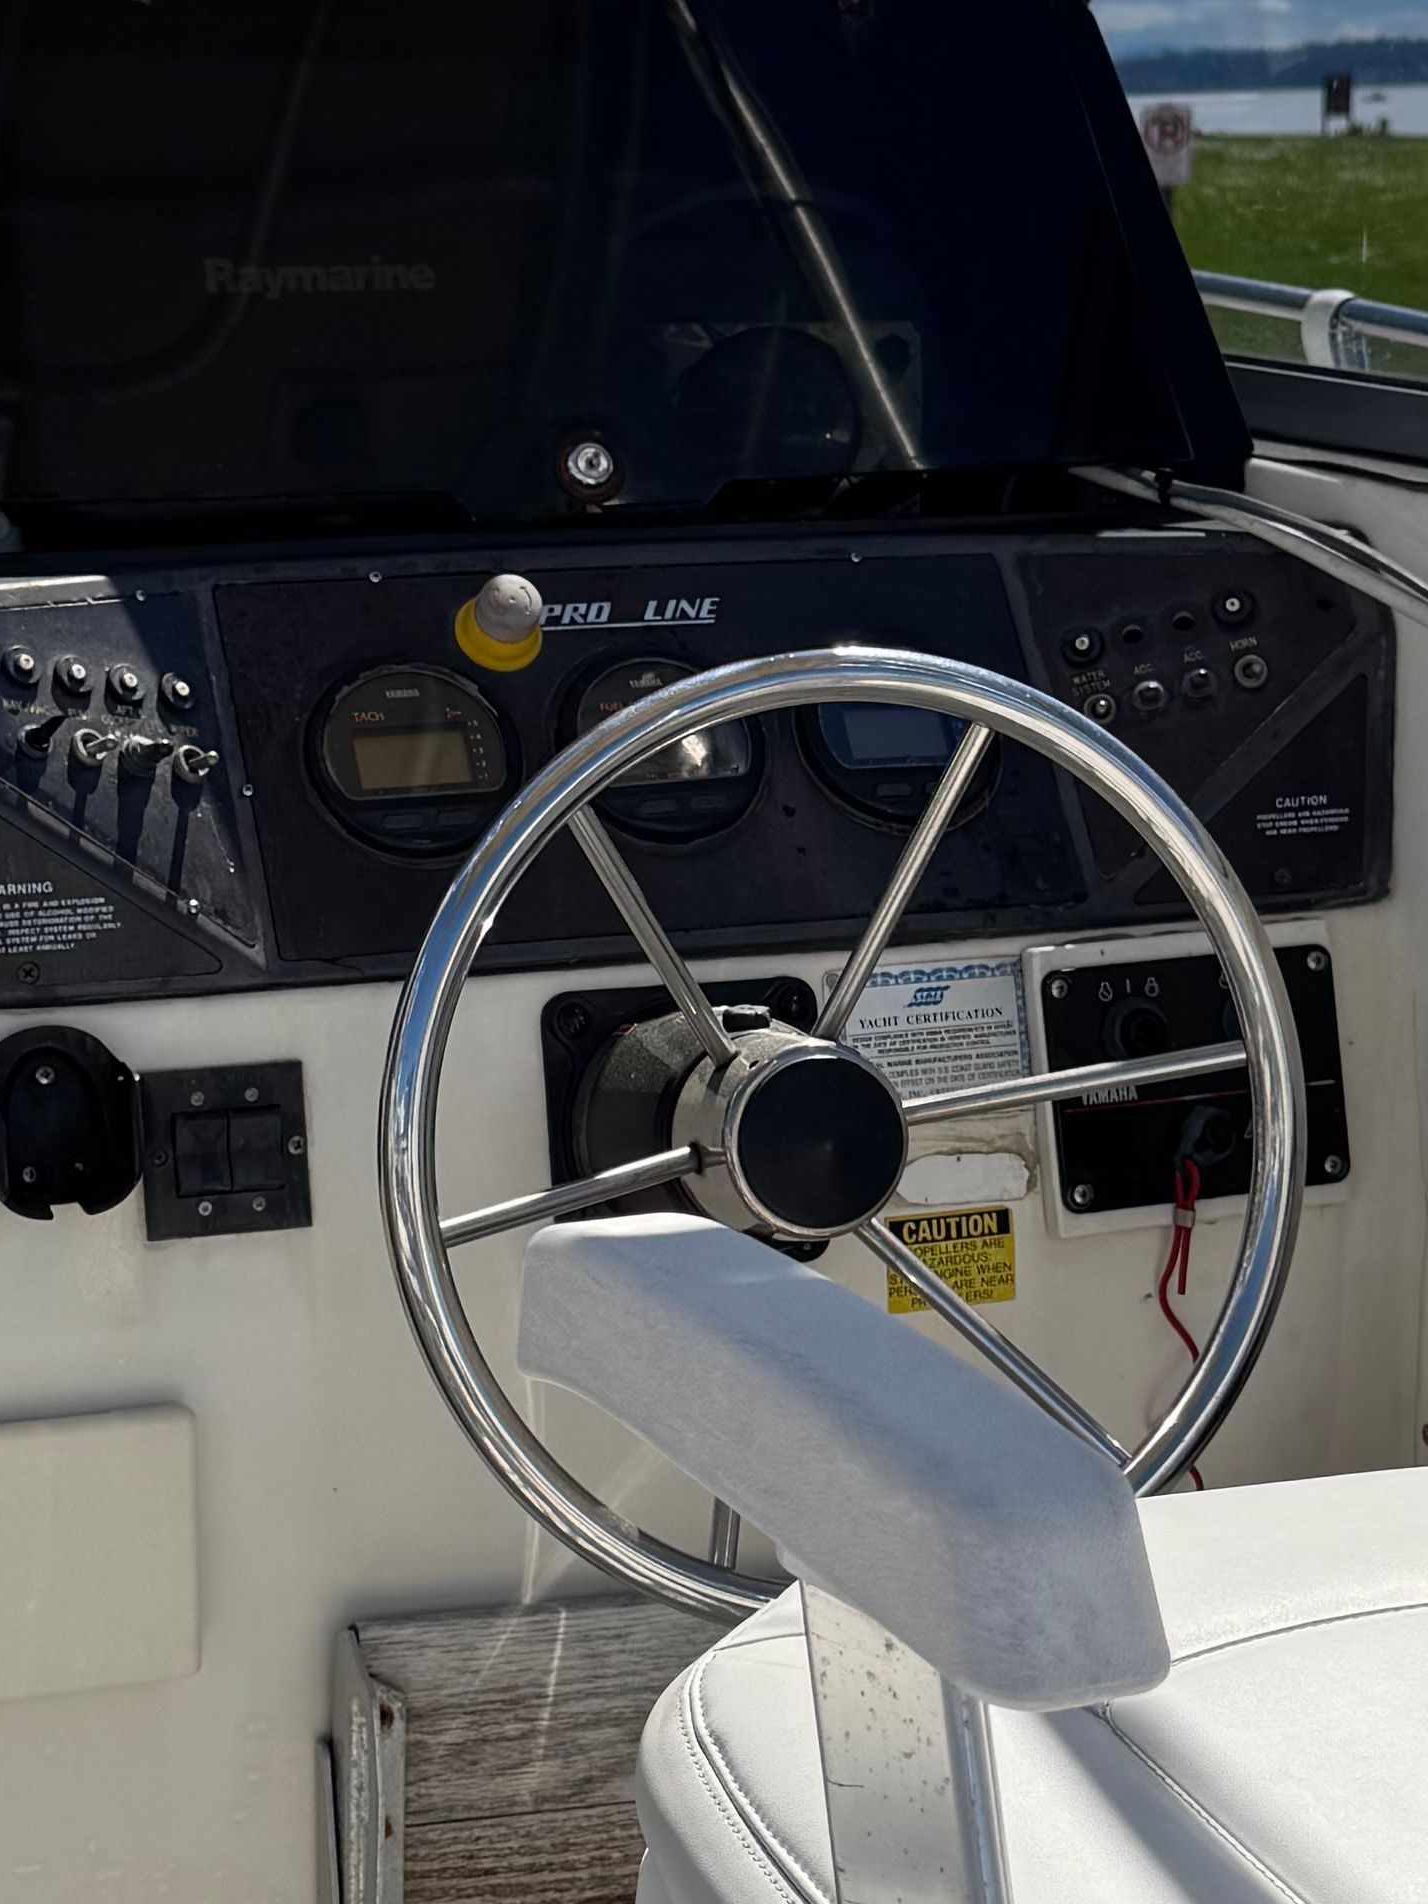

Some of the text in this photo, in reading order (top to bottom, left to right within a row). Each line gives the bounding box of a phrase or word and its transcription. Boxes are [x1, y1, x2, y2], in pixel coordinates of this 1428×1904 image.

[202, 255, 436, 300] Raymarine
[540, 597, 720, 625] PRO LINE
[1229, 637, 1259, 652] HORN
[352, 711, 385, 722] TACH
[1275, 794, 1327, 809] CAUTION
[859, 1007, 1004, 1029] YACHT CERTIFICATION
[1082, 1085, 1138, 1106] YAMAHA
[902, 1212, 998, 1244] CAUTION
[913, 1237, 1005, 1258] OPELLERS ARE
[976, 1261, 1012, 1275] WHEN
[952, 1274, 1014, 1290] ARE NEAR
